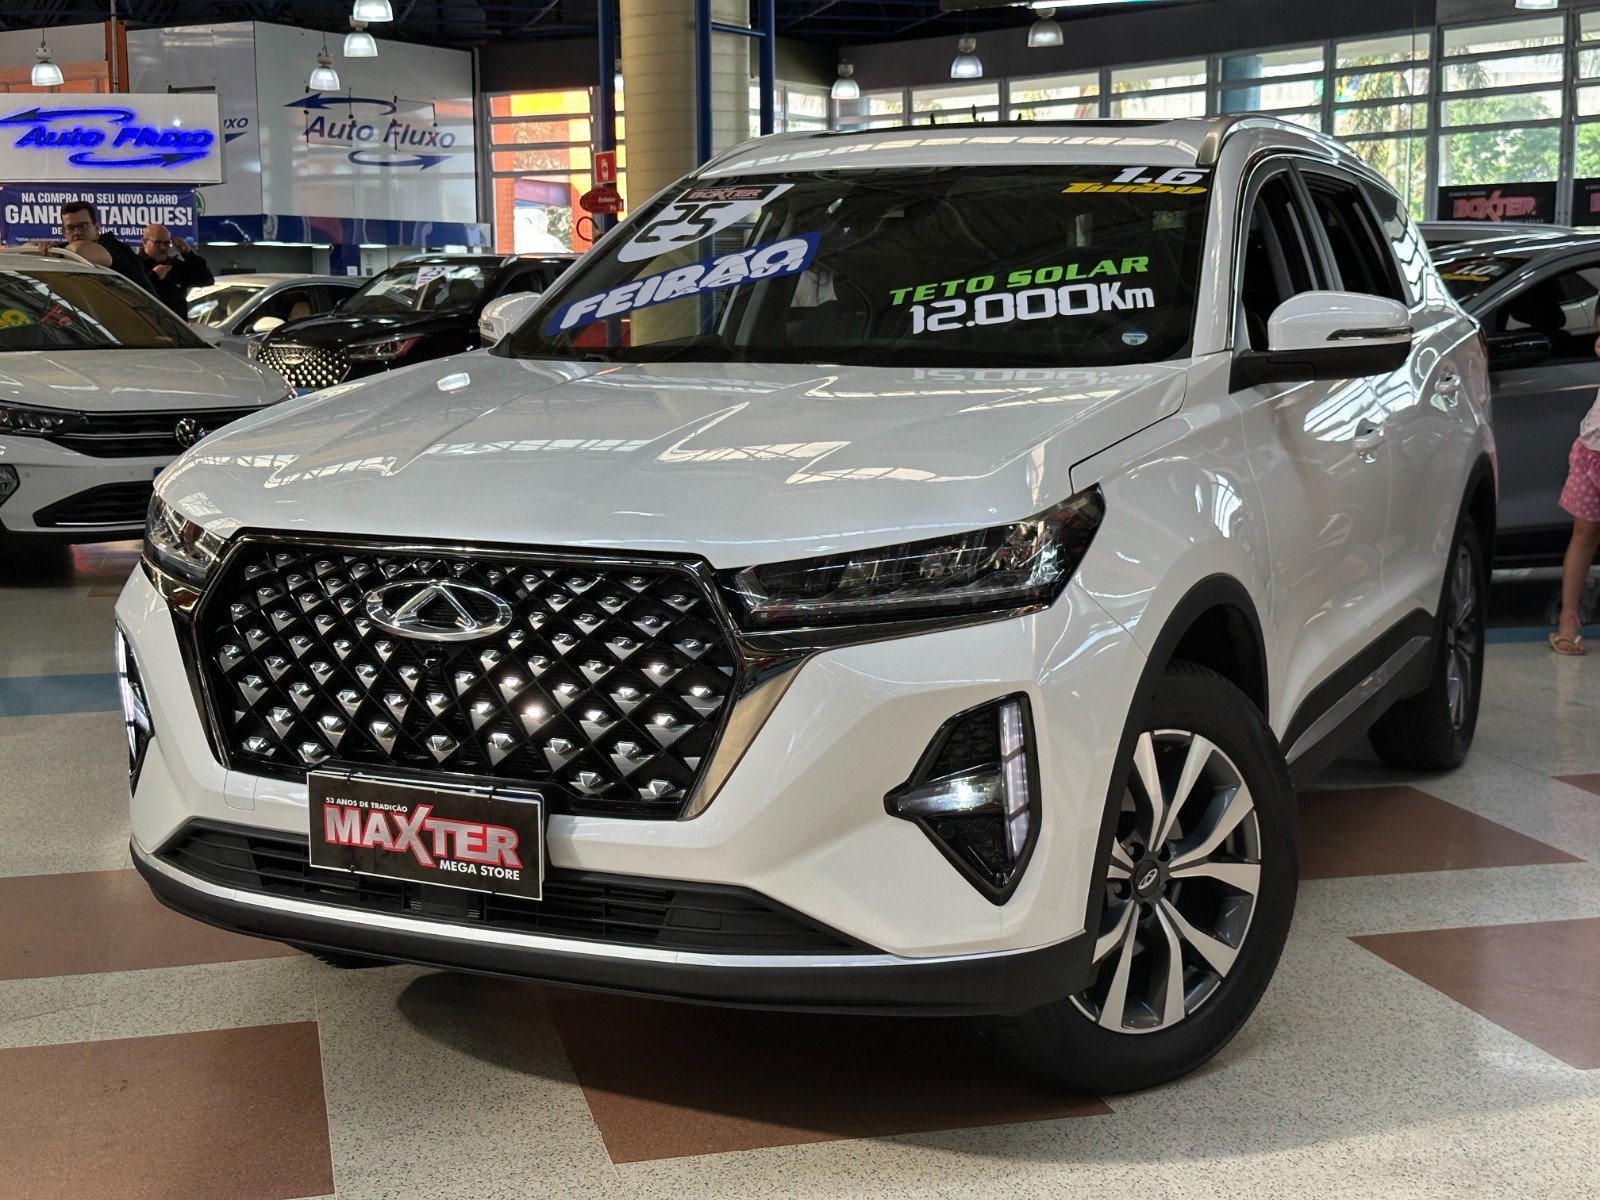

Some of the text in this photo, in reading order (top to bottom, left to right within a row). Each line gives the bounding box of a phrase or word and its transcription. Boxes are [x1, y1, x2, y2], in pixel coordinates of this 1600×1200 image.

[14, 126, 214, 148] Auto Fluxo
[303, 116, 456, 149] Auto Fluxo
[1112, 166, 1211, 185] 1.6
[21, 192, 178, 205] NA COMPRA DO SEU NOVO CARRO
[687, 184, 764, 201] BOXTER
[5, 204, 193, 226] GANH TANQUES!
[633, 202, 735, 244] 25
[51, 226, 63, 235] DE
[120, 226, 145, 236] GRÁTI
[889, 256, 1149, 306] TETO SOLAR
[908, 281, 1155, 335] 12.000Km
[336, 798, 358, 807] ANOS
[359, 800, 369, 808] DE
[370, 802, 408, 814] TRADIÇÃO
[323, 803, 524, 869] MAXTER
[439, 859, 521, 881] MEGA STORE
